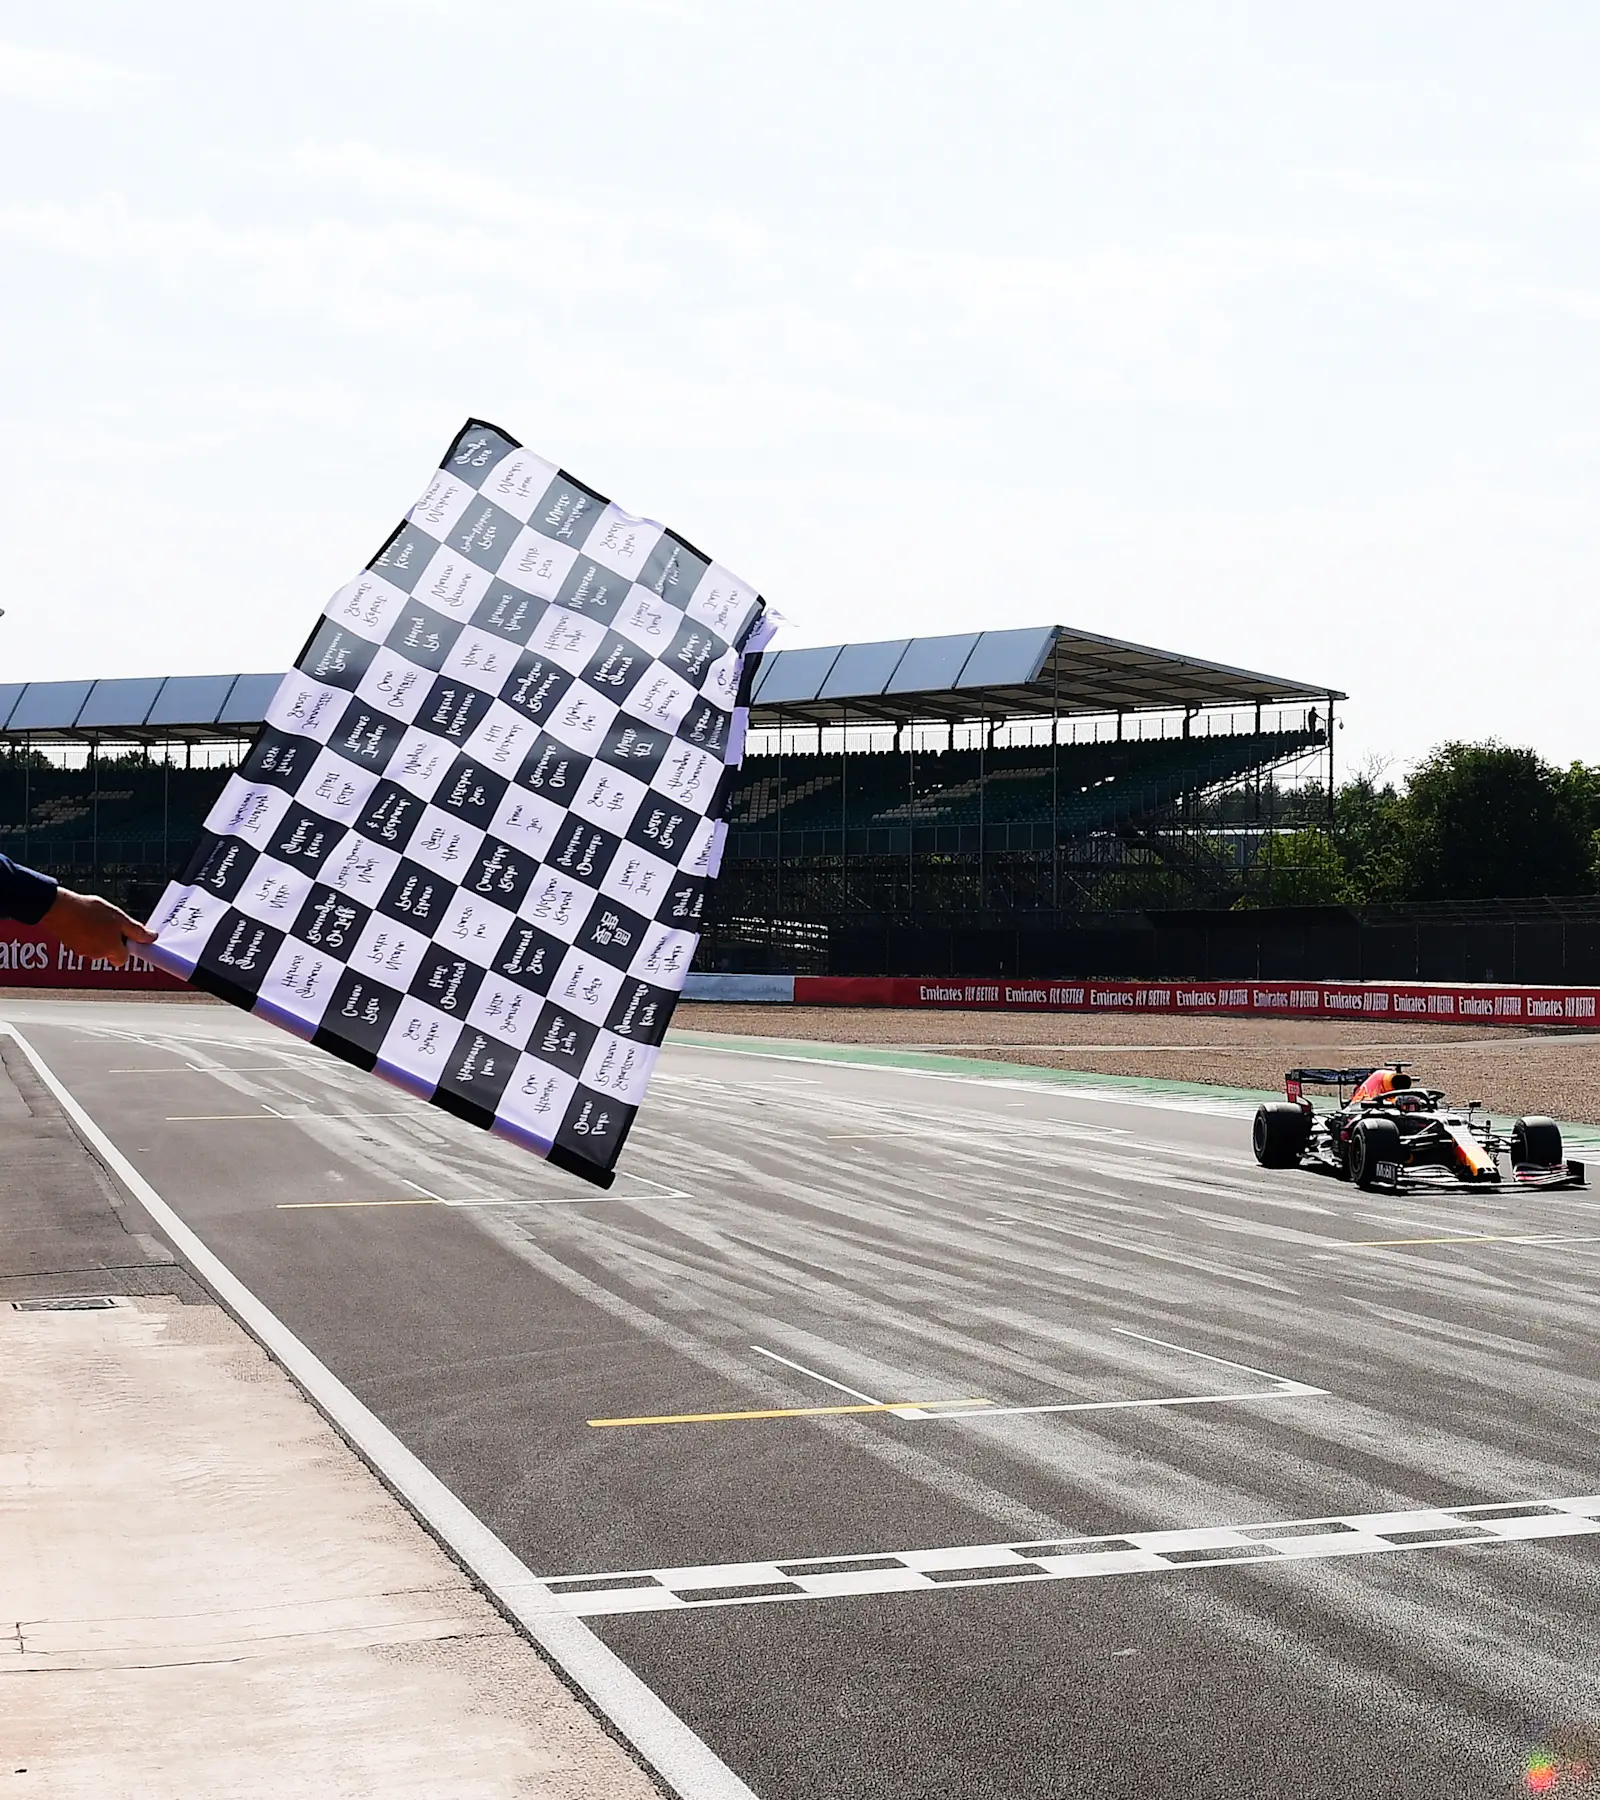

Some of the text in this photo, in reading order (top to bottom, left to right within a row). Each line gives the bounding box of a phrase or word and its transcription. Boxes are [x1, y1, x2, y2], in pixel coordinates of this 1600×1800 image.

[920, 985, 962, 1001] Emirates
[1005, 986, 1047, 1003] Emirates
[1090, 989, 1134, 1006] Emirates
[1176, 989, 1216, 1006] Emirates
[1323, 991, 1362, 1010] Emirates
[1393, 993, 1426, 1013] Emirates
[1458, 995, 1493, 1016] Emirates
[1526, 996, 1563, 1018] Emirates
